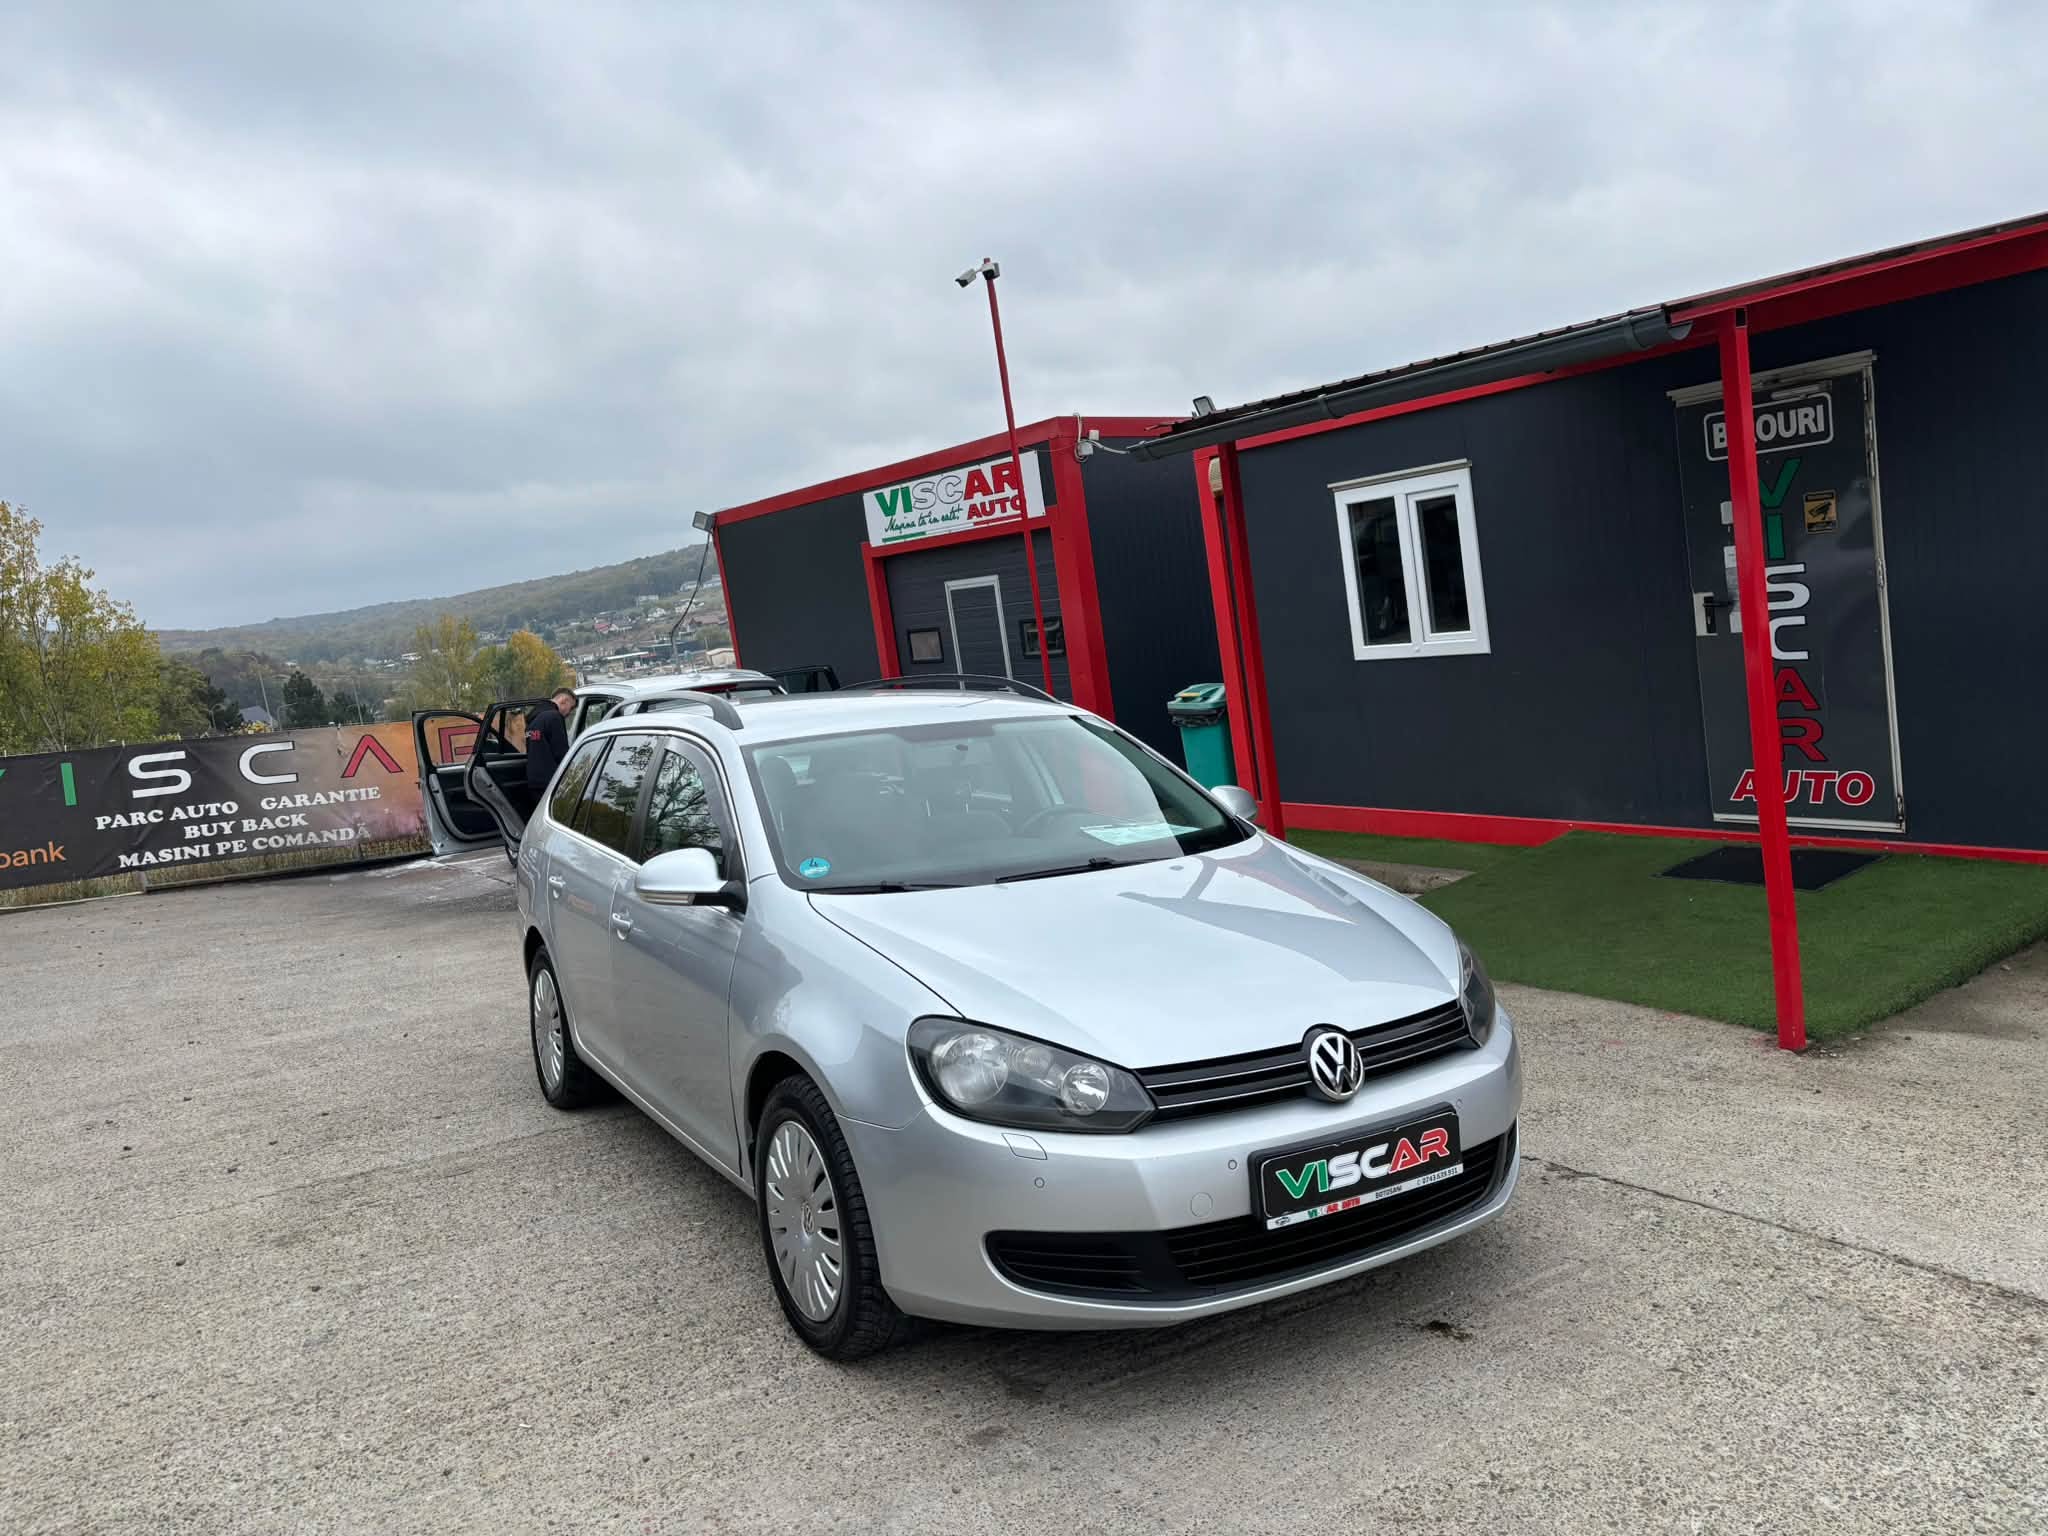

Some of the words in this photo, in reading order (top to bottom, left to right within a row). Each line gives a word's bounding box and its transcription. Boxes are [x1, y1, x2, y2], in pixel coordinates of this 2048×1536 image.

[1713, 404, 1825, 449] BOURI
[875, 461, 1018, 518] VISCAR
[95, 809, 164, 830] PARC
[169, 801, 239, 821] AUTO
[260, 786, 381, 810] GARANTIE
[184, 821, 236, 839] BUY
[241, 813, 309, 832] BACK
[118, 844, 211, 868] MASINI
[216, 839, 247, 856] PE
[1275, 1127, 1450, 1199] VISCAR
